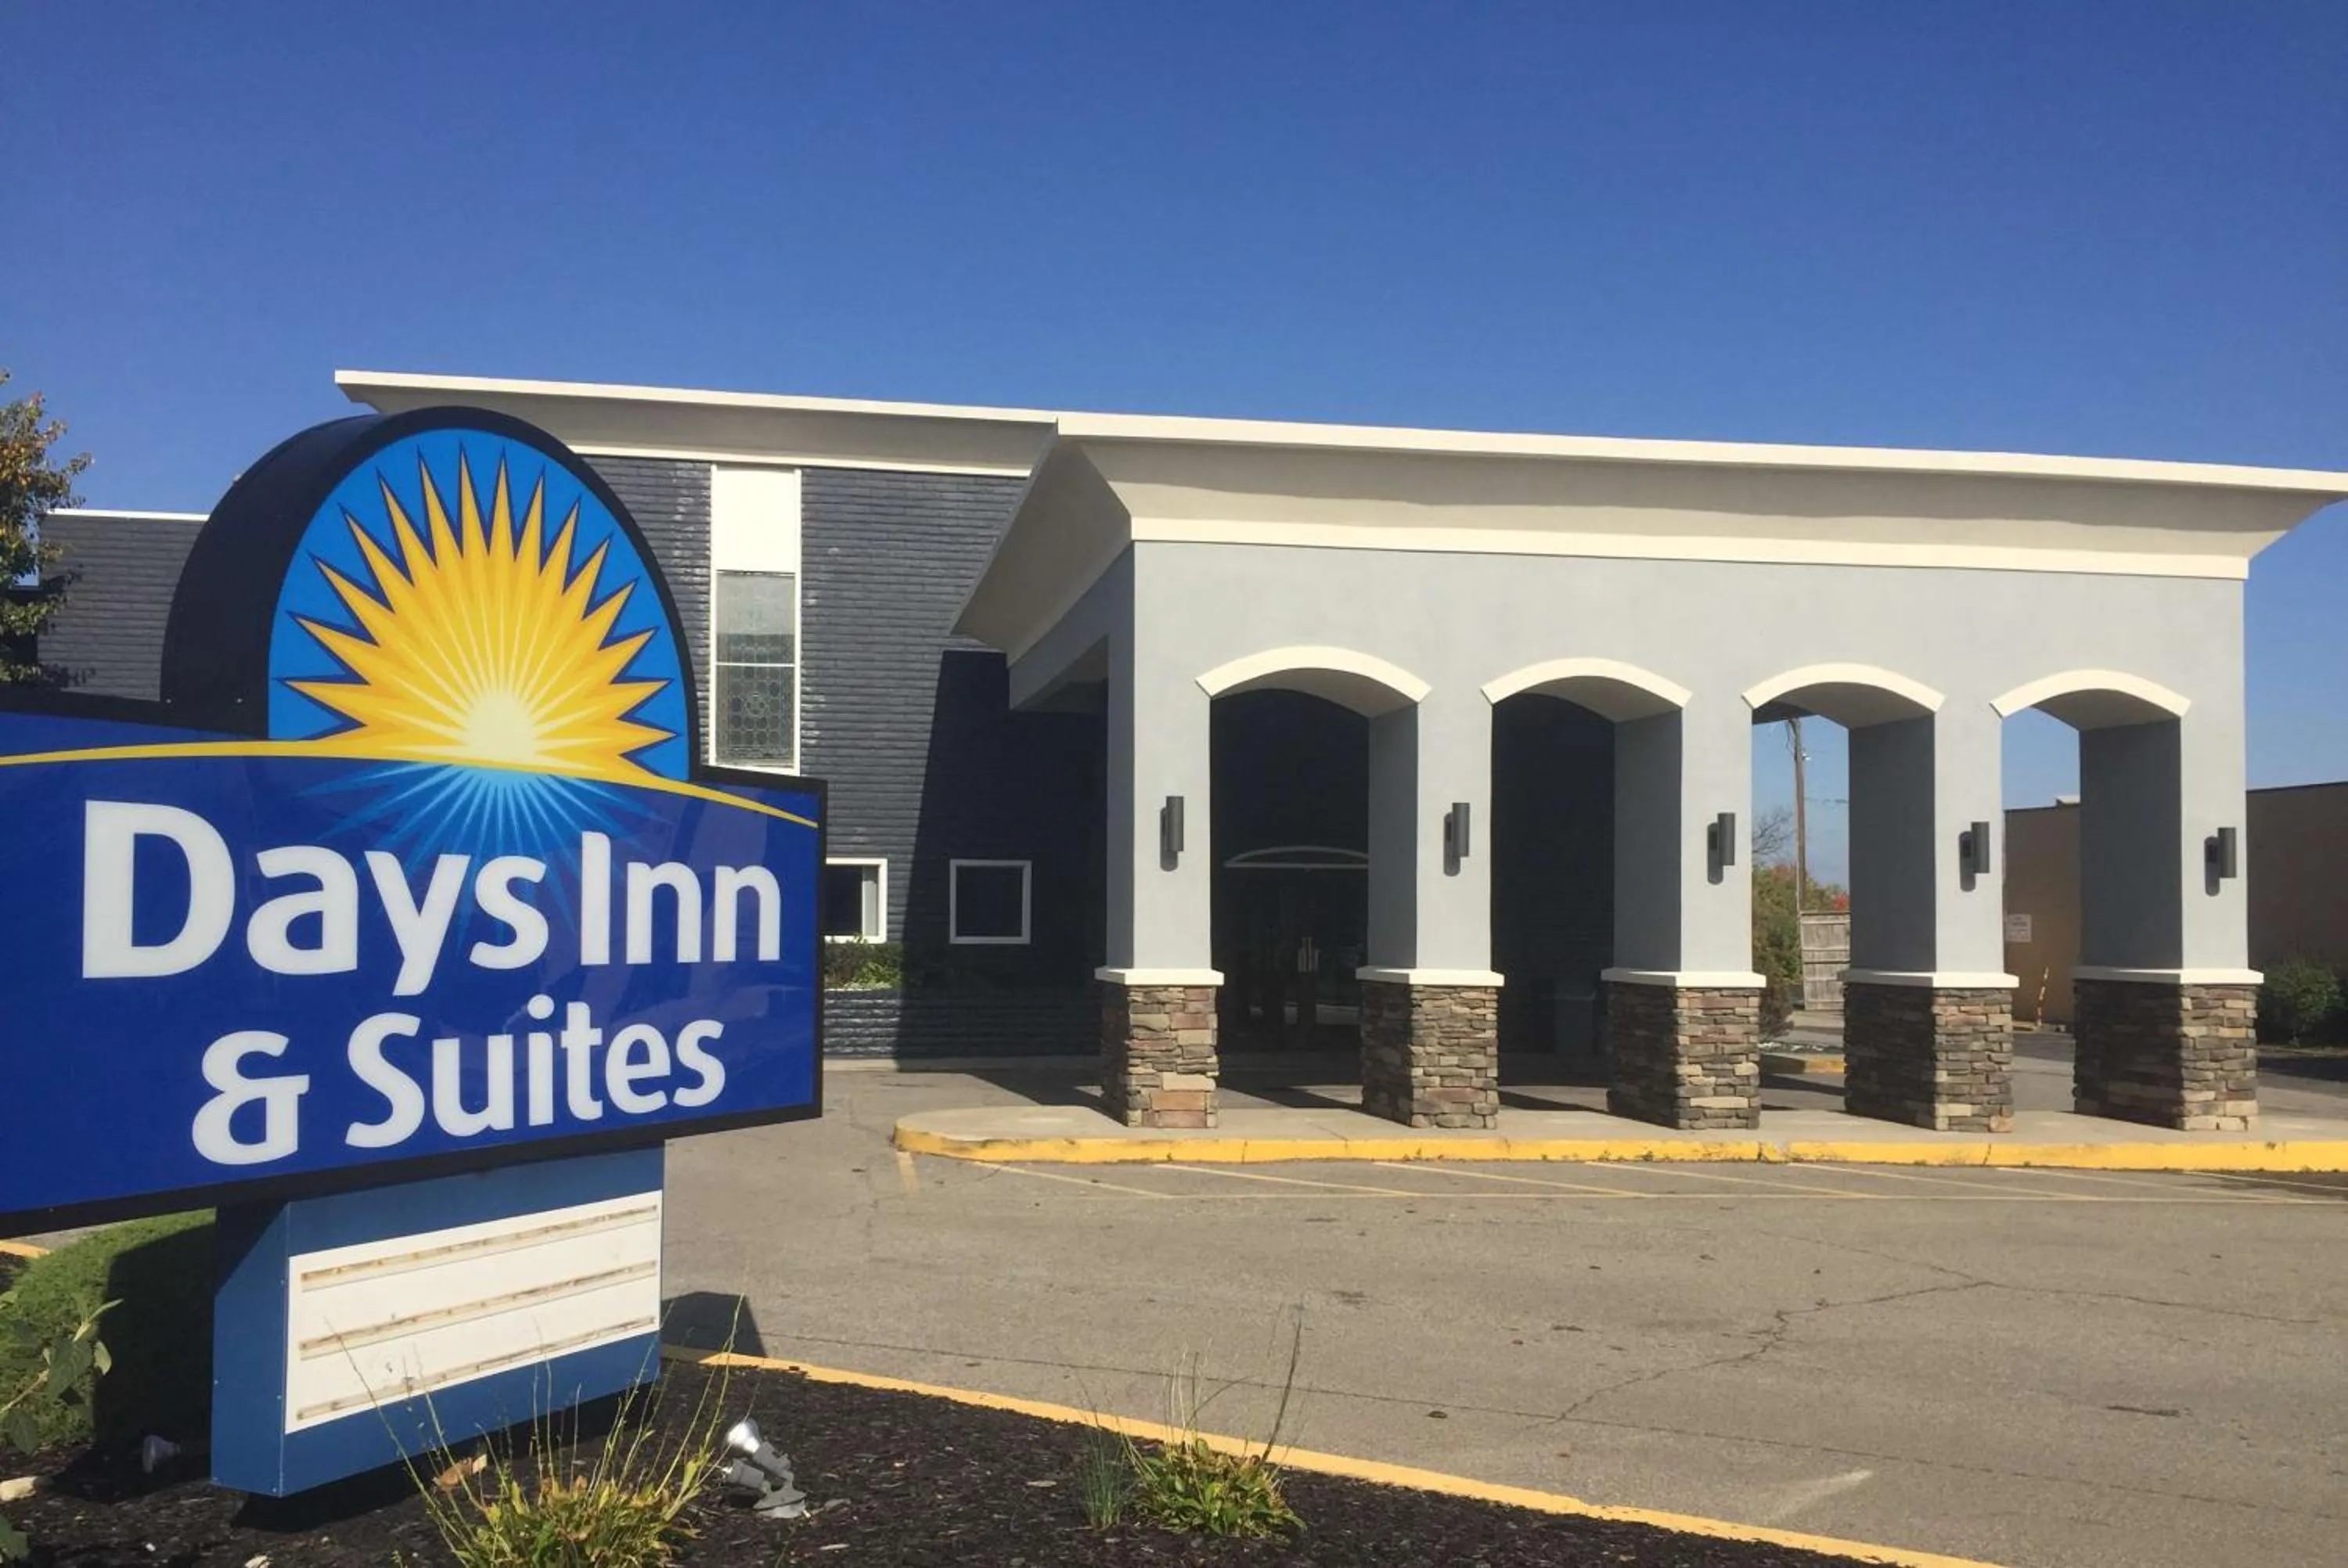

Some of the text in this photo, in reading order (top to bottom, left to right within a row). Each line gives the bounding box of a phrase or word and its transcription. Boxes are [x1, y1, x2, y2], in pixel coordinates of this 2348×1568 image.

[83, 800, 780, 996] Days Inn
[192, 994, 726, 1165] & Suites
